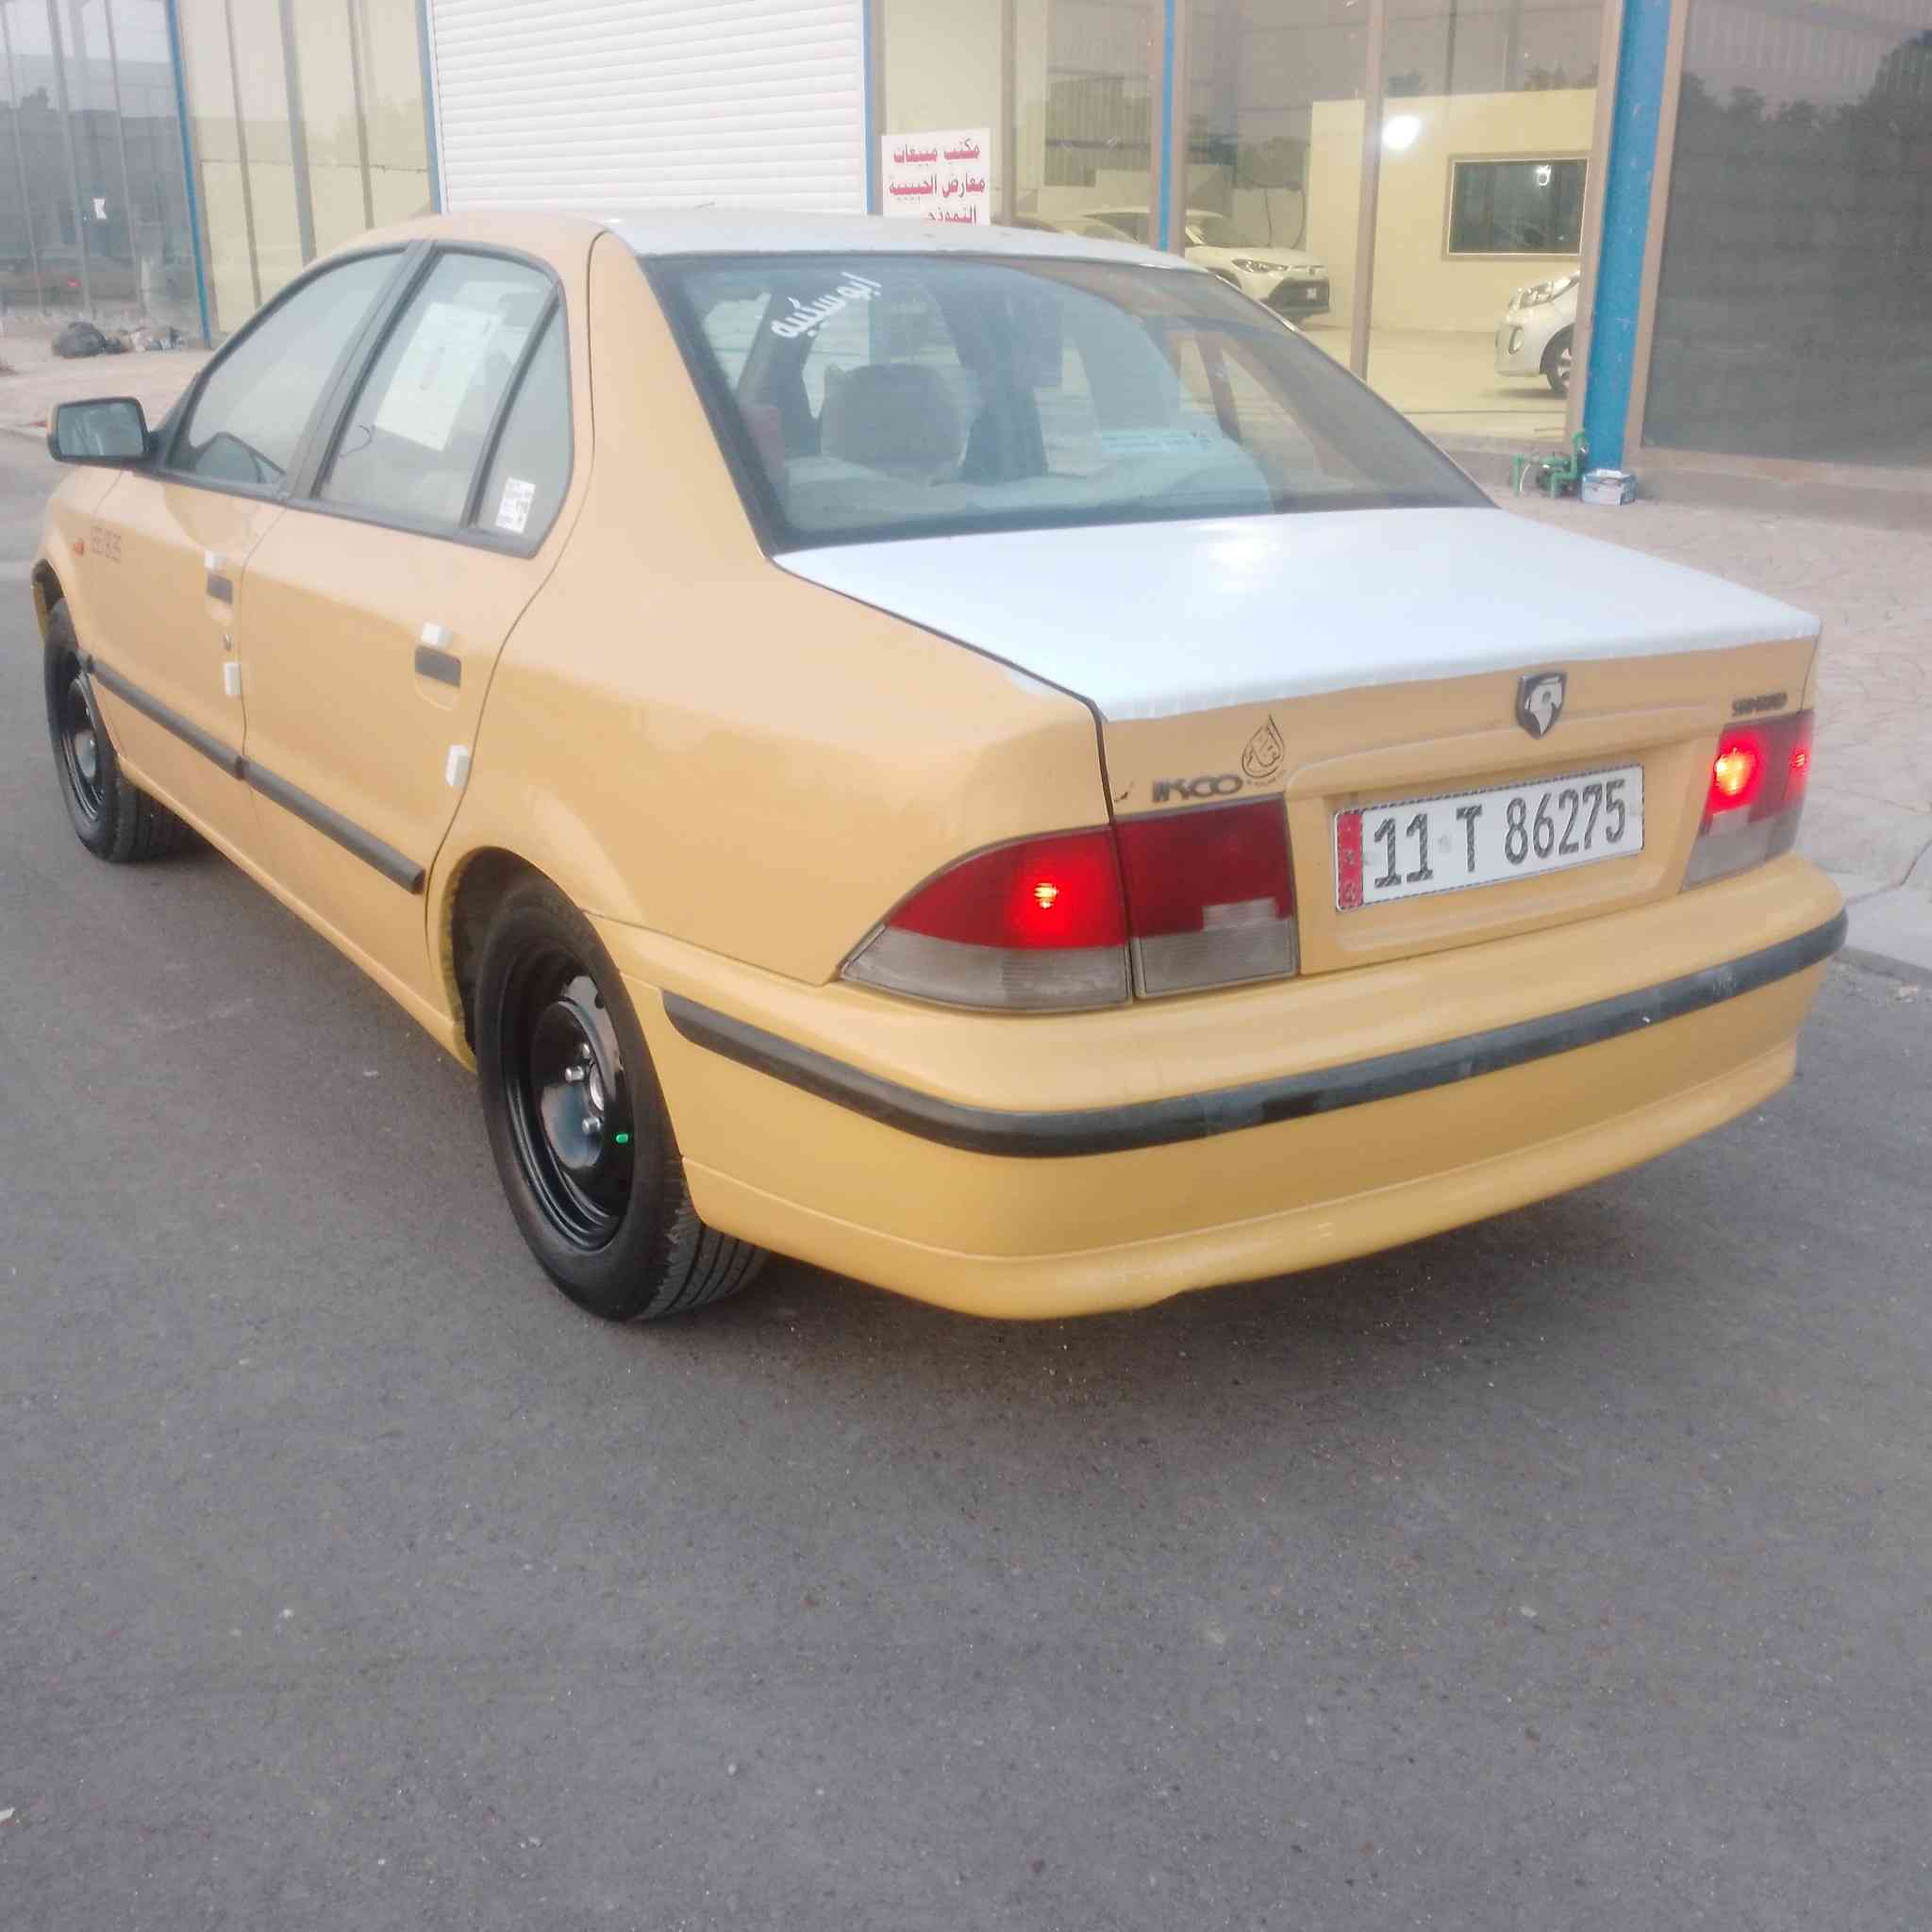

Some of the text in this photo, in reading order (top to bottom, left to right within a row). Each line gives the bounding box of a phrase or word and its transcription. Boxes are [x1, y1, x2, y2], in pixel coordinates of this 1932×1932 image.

[893, 138, 981, 166] مكتب مبيعات
[941, 173, 986, 198] معارض
[1373, 812, 1434, 889] 11
[1456, 804, 1483, 873] T
[1504, 777, 1626, 865] 86275
